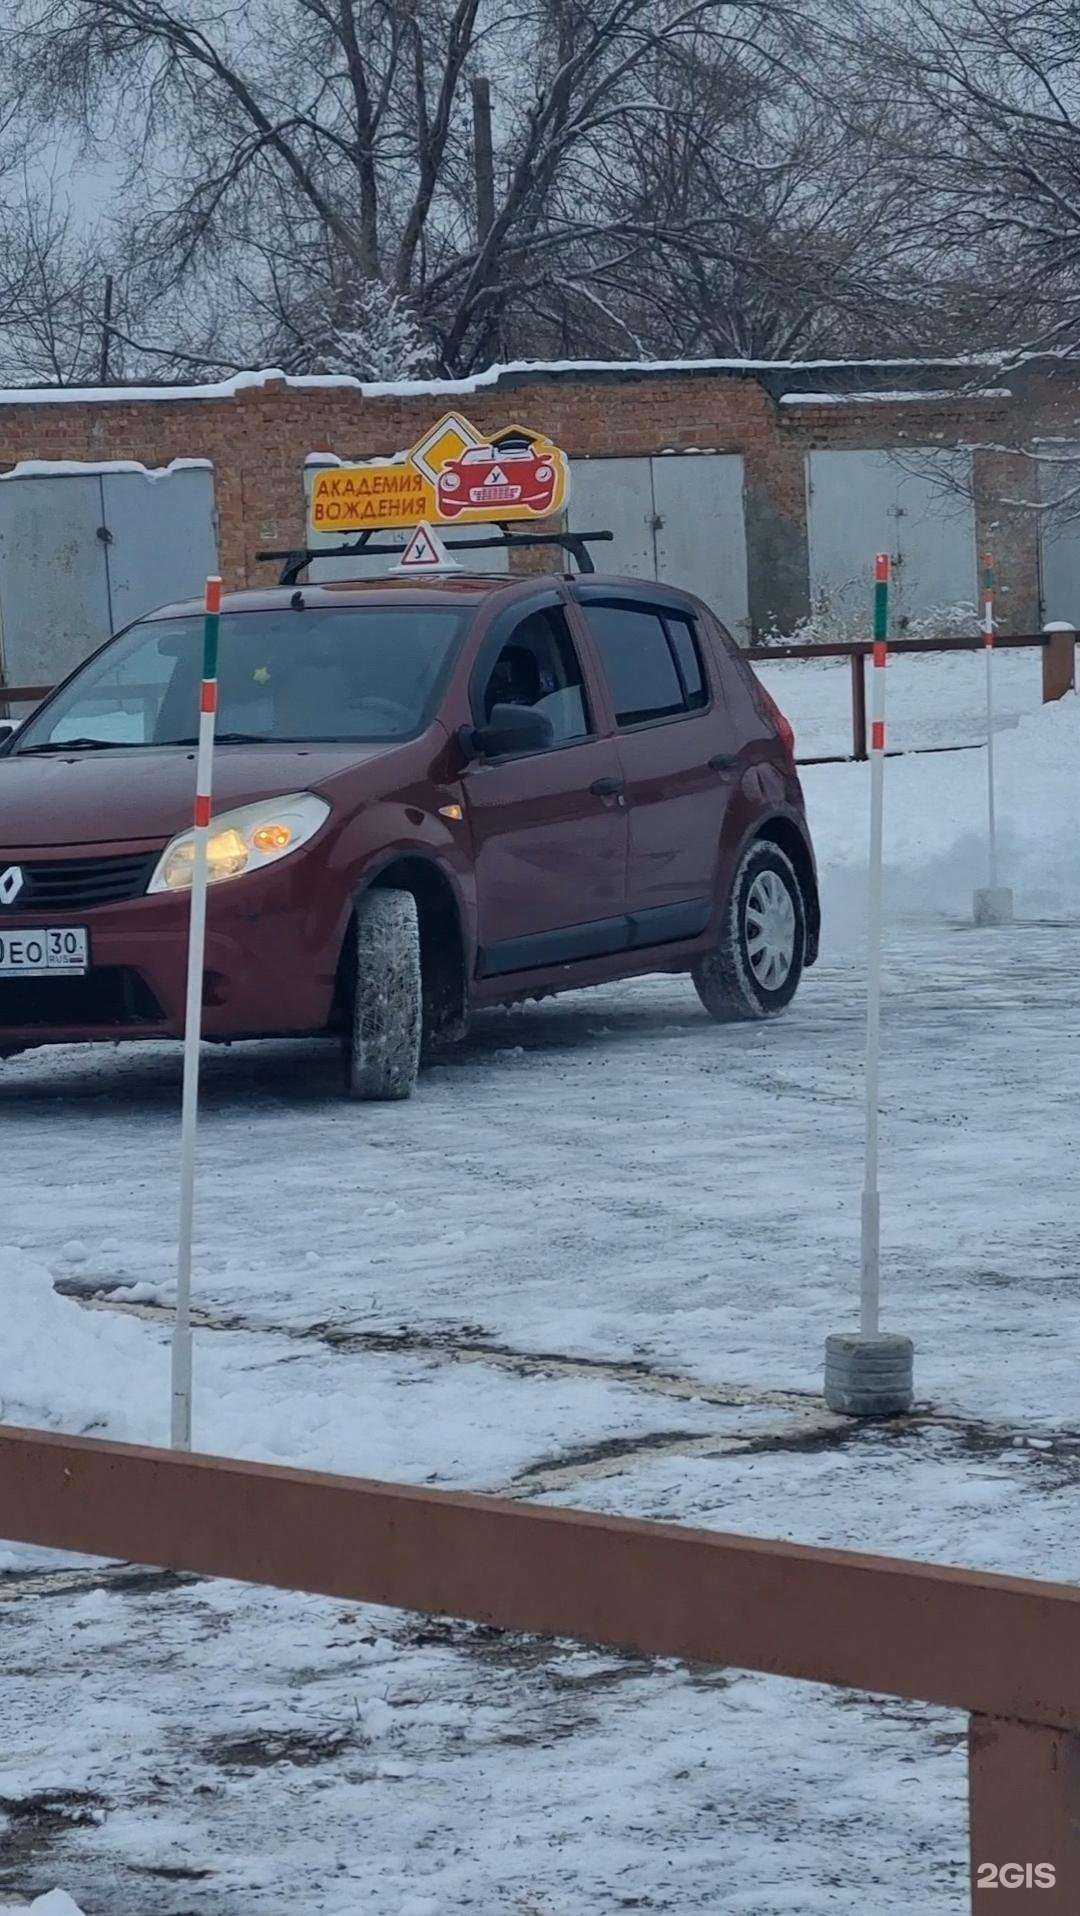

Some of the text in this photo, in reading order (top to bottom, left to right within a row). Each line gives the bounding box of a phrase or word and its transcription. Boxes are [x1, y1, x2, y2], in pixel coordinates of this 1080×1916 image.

[316, 474, 423, 498] АКАДЕМИЯ
[315, 497, 426, 521] ВОЖДЕНИЯ
[49, 955, 69, 964] RUS
